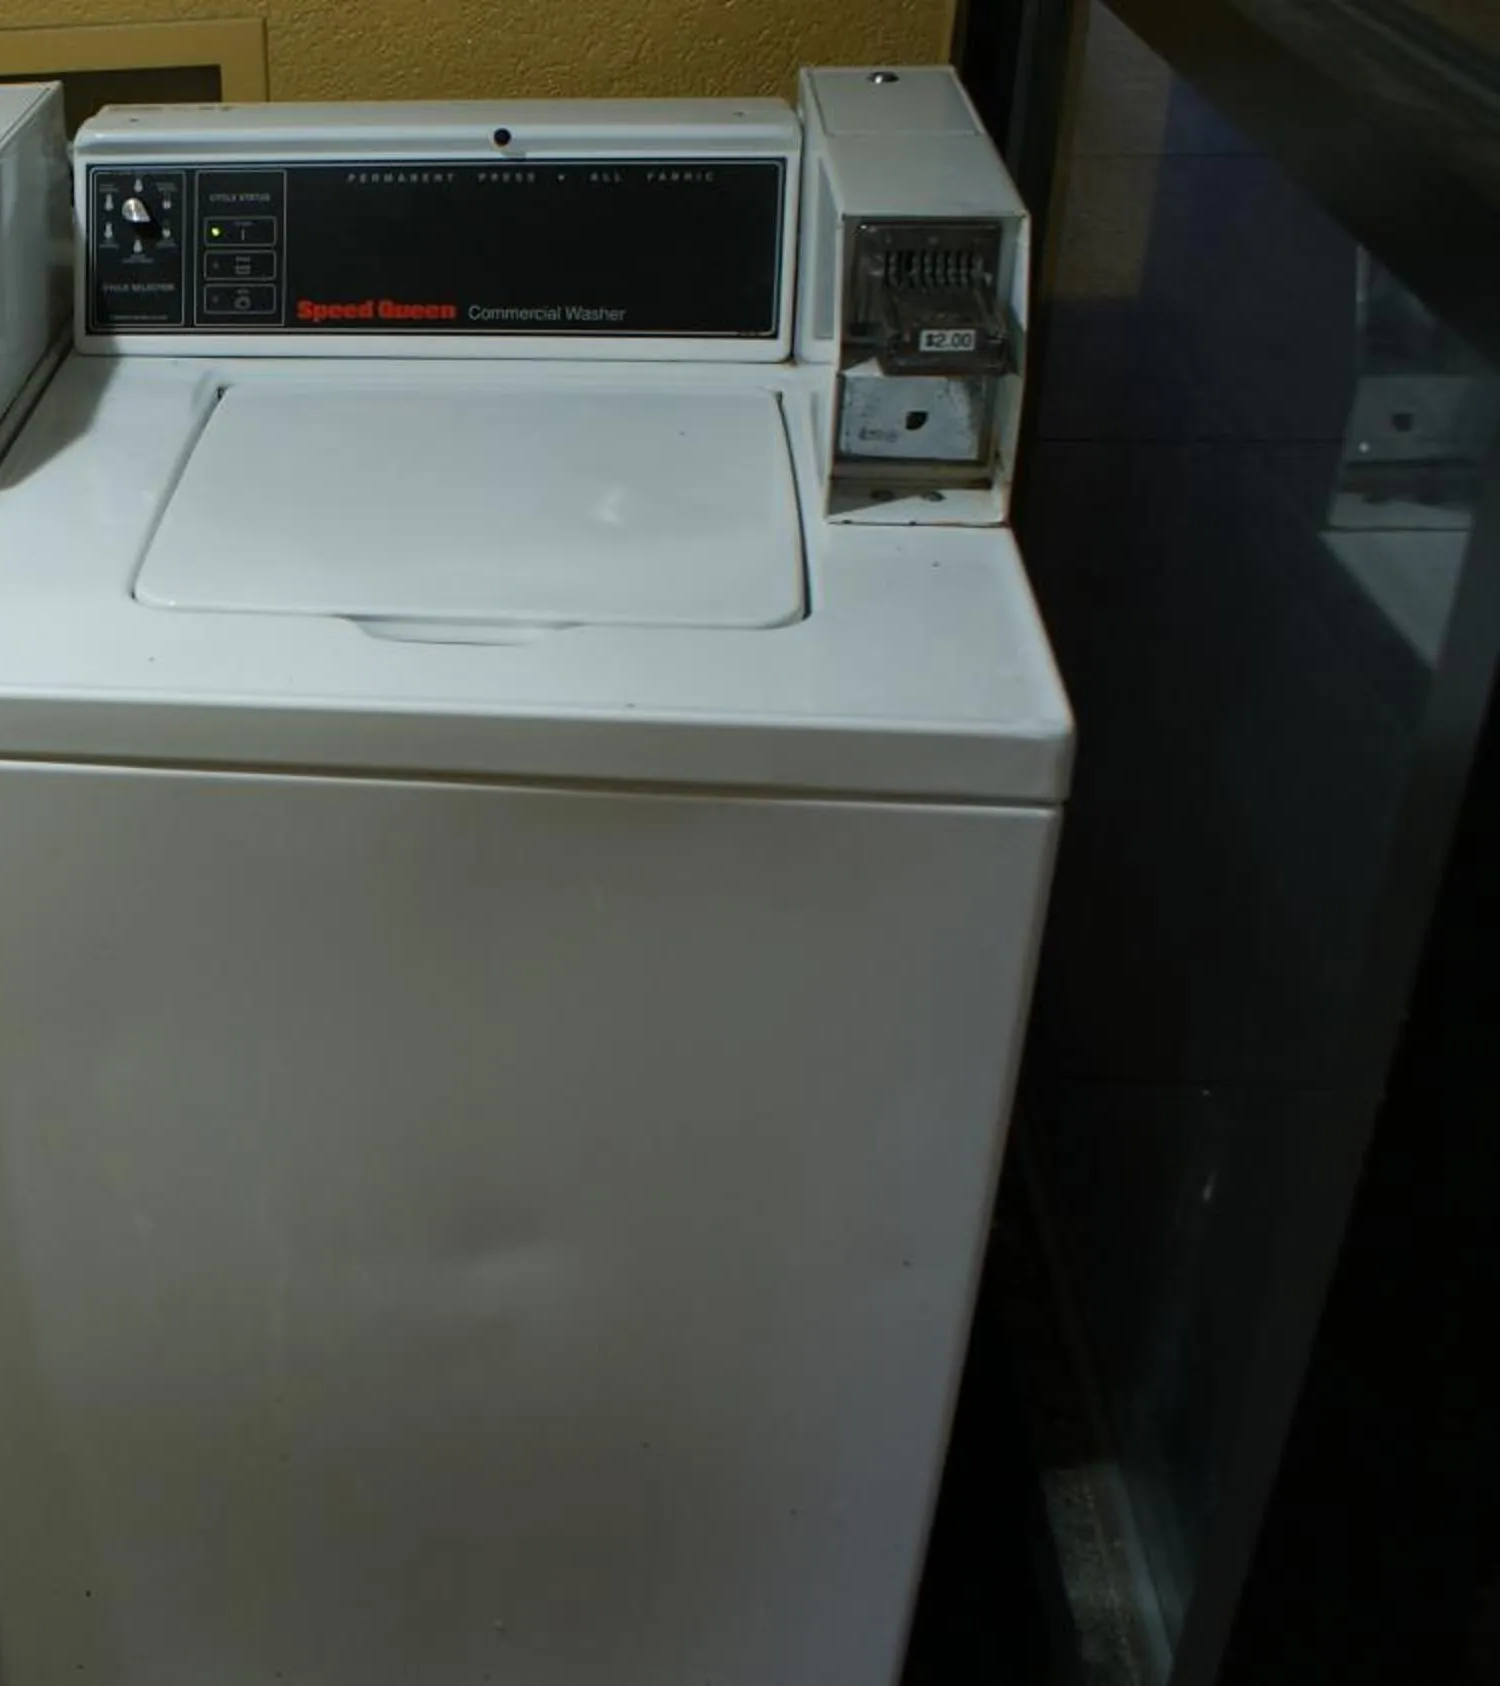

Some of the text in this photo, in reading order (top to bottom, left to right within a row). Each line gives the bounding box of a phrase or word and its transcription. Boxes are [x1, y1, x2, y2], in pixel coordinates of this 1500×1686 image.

[347, 171, 716, 184] PERMANENT PRESS ALL FABRIC
[297, 301, 627, 323] Speed Queen Commercial Washer
[925, 332, 972, 349] $2.00
